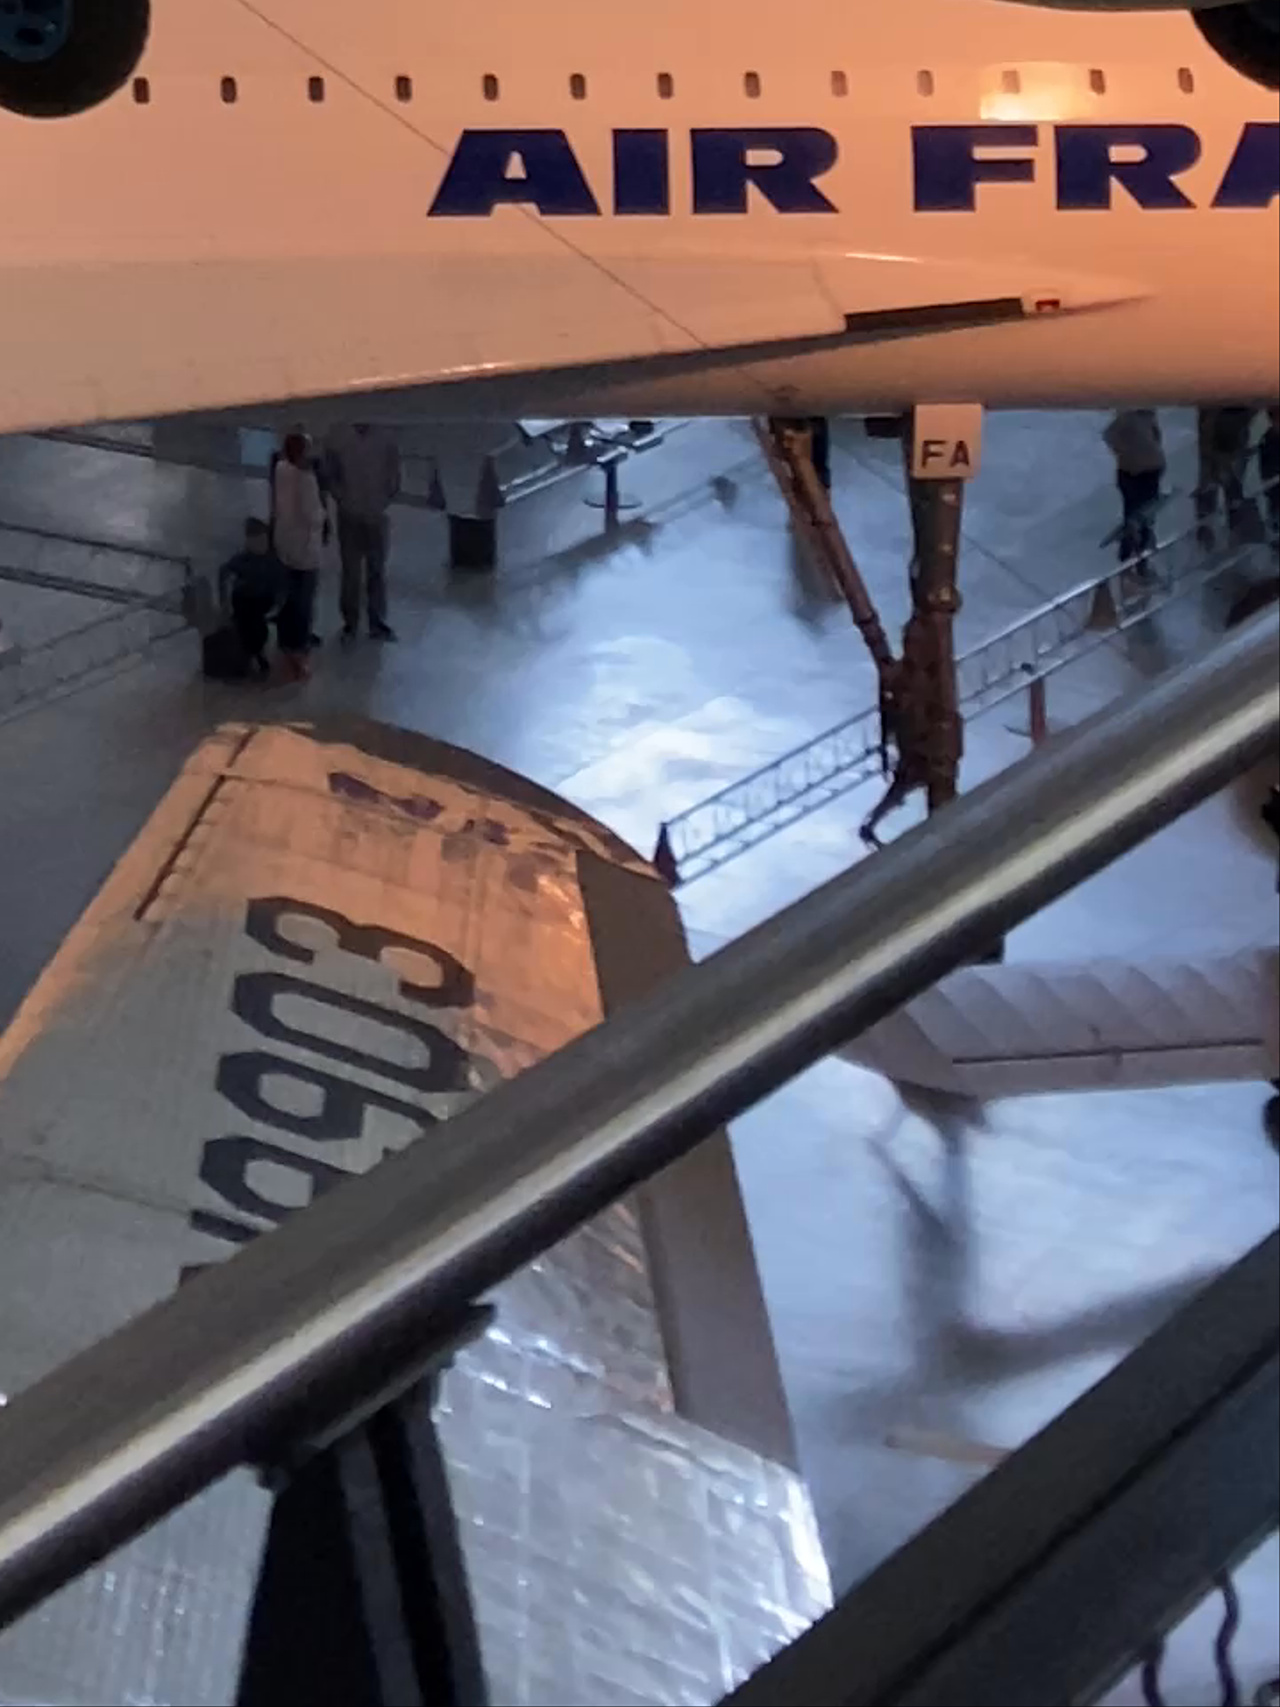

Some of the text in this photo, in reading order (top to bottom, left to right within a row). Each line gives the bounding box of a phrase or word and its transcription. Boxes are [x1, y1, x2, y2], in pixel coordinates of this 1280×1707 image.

[426, 127, 840, 217] AIR
[920, 437, 972, 470] FA
[179, 895, 474, 1286] 9903
